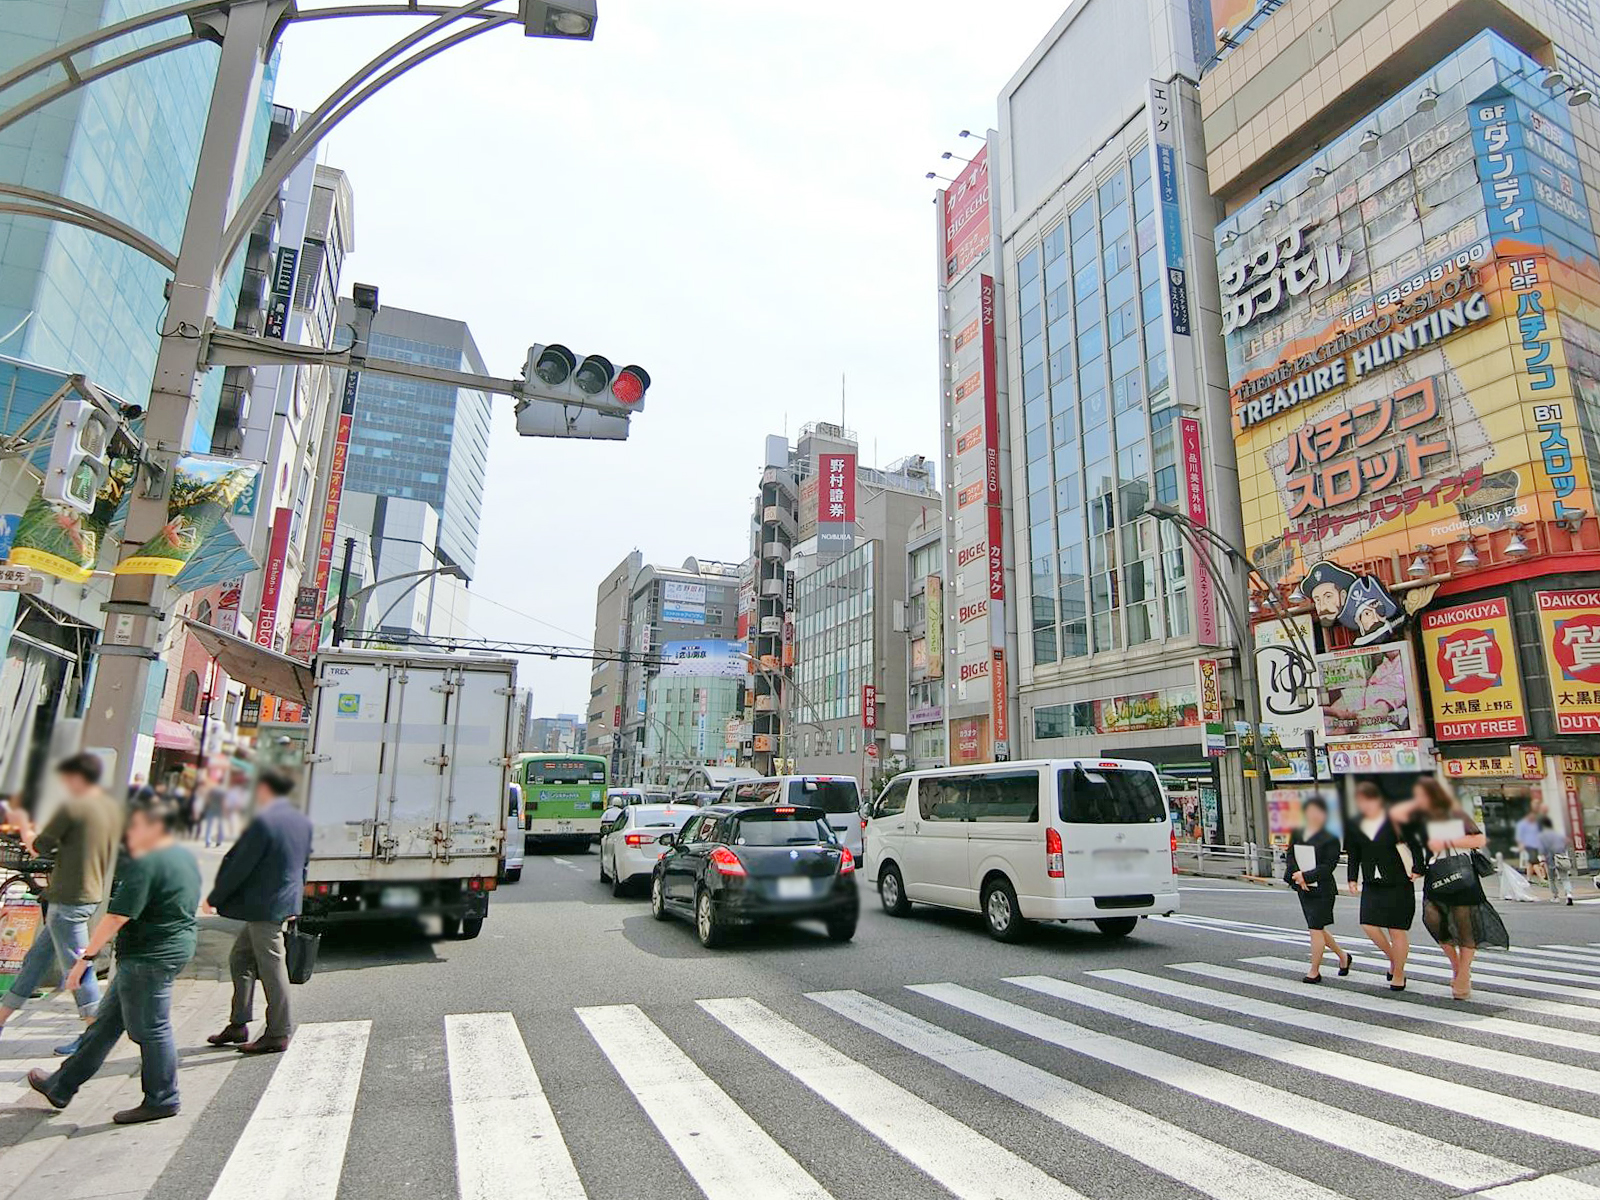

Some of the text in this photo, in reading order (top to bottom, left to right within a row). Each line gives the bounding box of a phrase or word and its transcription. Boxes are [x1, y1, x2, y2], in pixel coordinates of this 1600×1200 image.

[1154, 88, 1169, 132] エッグ
[1479, 105, 1506, 121] 6F
[1484, 120, 1525, 233] ダンディ
[947, 212, 965, 242] BIG
[1222, 219, 1320, 296] サウナ
[1510, 259, 1536, 275] 1F
[1220, 242, 1354, 336] カプセル
[1342, 244, 1484, 327] TEL 3839-8100
[1511, 274, 1537, 290] 2F
[1239, 291, 1490, 429] TREASURE HUNTING
[1517, 293, 1556, 391] パチンコ
[1184, 425, 1195, 433] 4F
[1285, 375, 1440, 475] パチンコ
[1533, 404, 1562, 422] B1
[329, 445, 346, 499] カラオケ
[1286, 434, 1450, 520] スロット
[1537, 422, 1584, 528] スロット
[1430, 502, 1528, 538] Produced by Egg
[990, 545, 1003, 594] カラオケ
[1428, 604, 1500, 627] DAIKOKUYA
[1540, 592, 1600, 608] DAIKOK
[1443, 635, 1498, 685] 質
[1441, 699, 1513, 715] 大黒屋 上野店
[1442, 719, 1517, 737] DUTY FREE
[1467, 759, 1503, 771] 大黒屋
